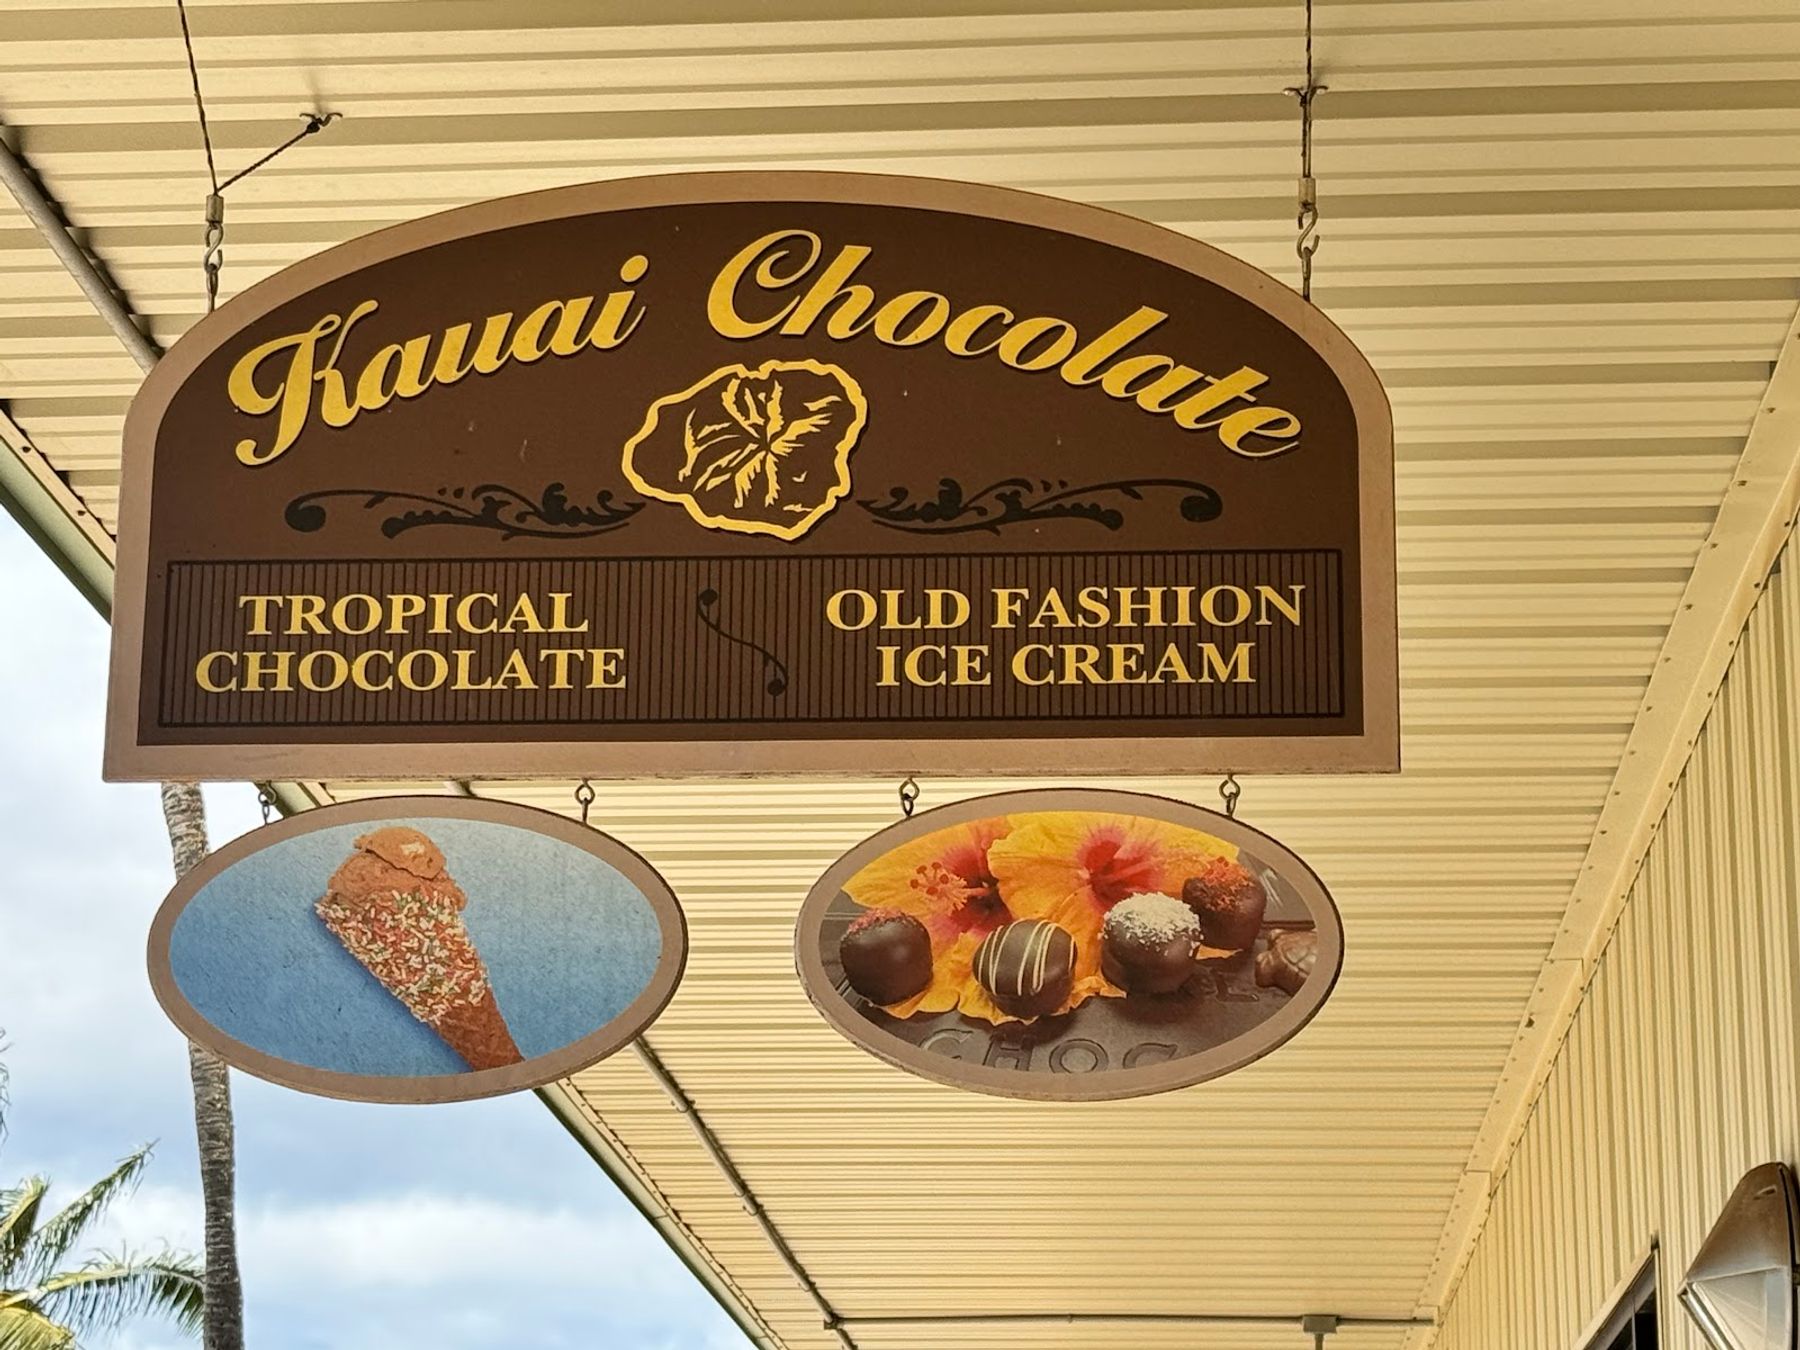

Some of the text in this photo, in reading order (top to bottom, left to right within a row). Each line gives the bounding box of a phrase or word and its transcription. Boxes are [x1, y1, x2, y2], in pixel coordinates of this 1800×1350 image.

[227, 228, 1303, 466] Kauai Chocolate
[238, 592, 589, 635] TROPICAL
[826, 584, 1306, 631] OLD FASHION
[195, 648, 627, 693] CHOCOLATE
[876, 642, 1256, 687] ICE CREAM
